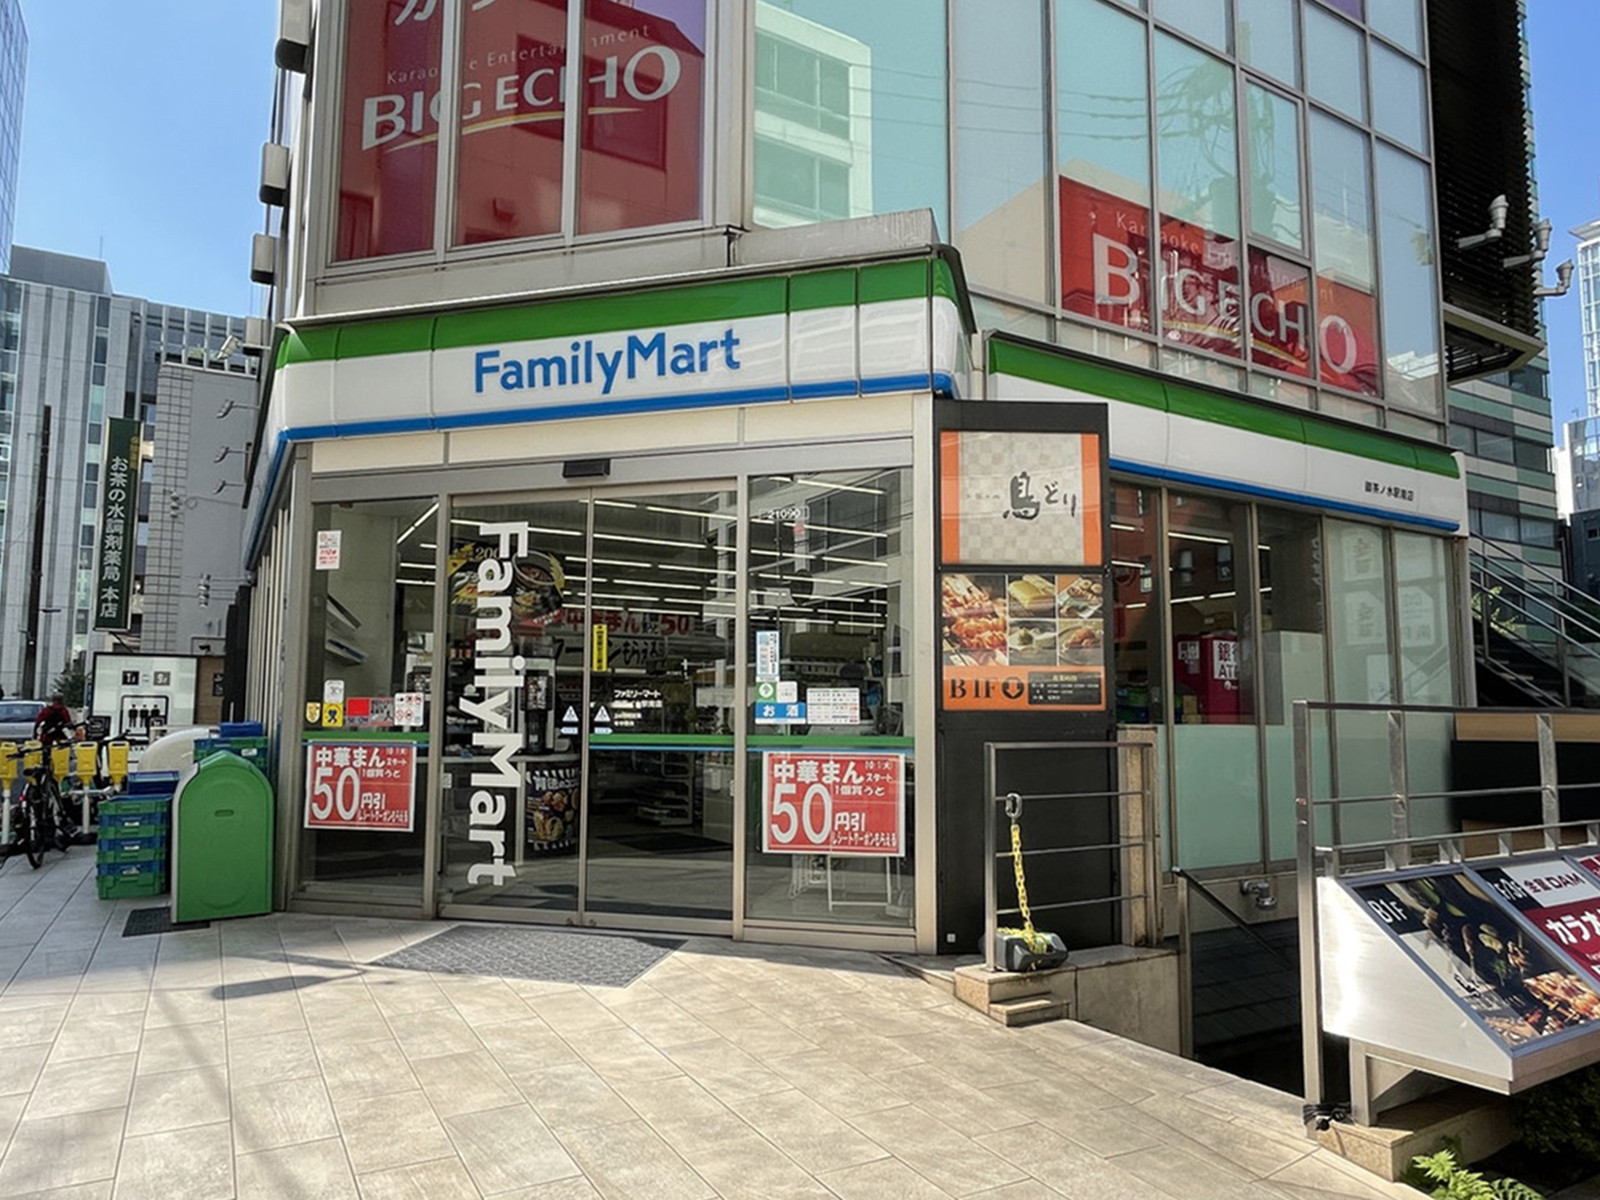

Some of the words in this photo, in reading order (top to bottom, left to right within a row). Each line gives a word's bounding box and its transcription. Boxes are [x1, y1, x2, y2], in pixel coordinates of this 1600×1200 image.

[387, 60, 478, 84] Karaoe
[1218, 279, 1357, 374] ECHO
[475, 329, 741, 395] FamilyMart
[100, 586, 119, 619] 本店
[459, 521, 529, 887] FamilyMart
[316, 746, 386, 768] 中華まん
[774, 760, 864, 784] 中華まん
[311, 767, 360, 820] 50
[771, 783, 832, 844] 50
[834, 812, 866, 832] 円引
